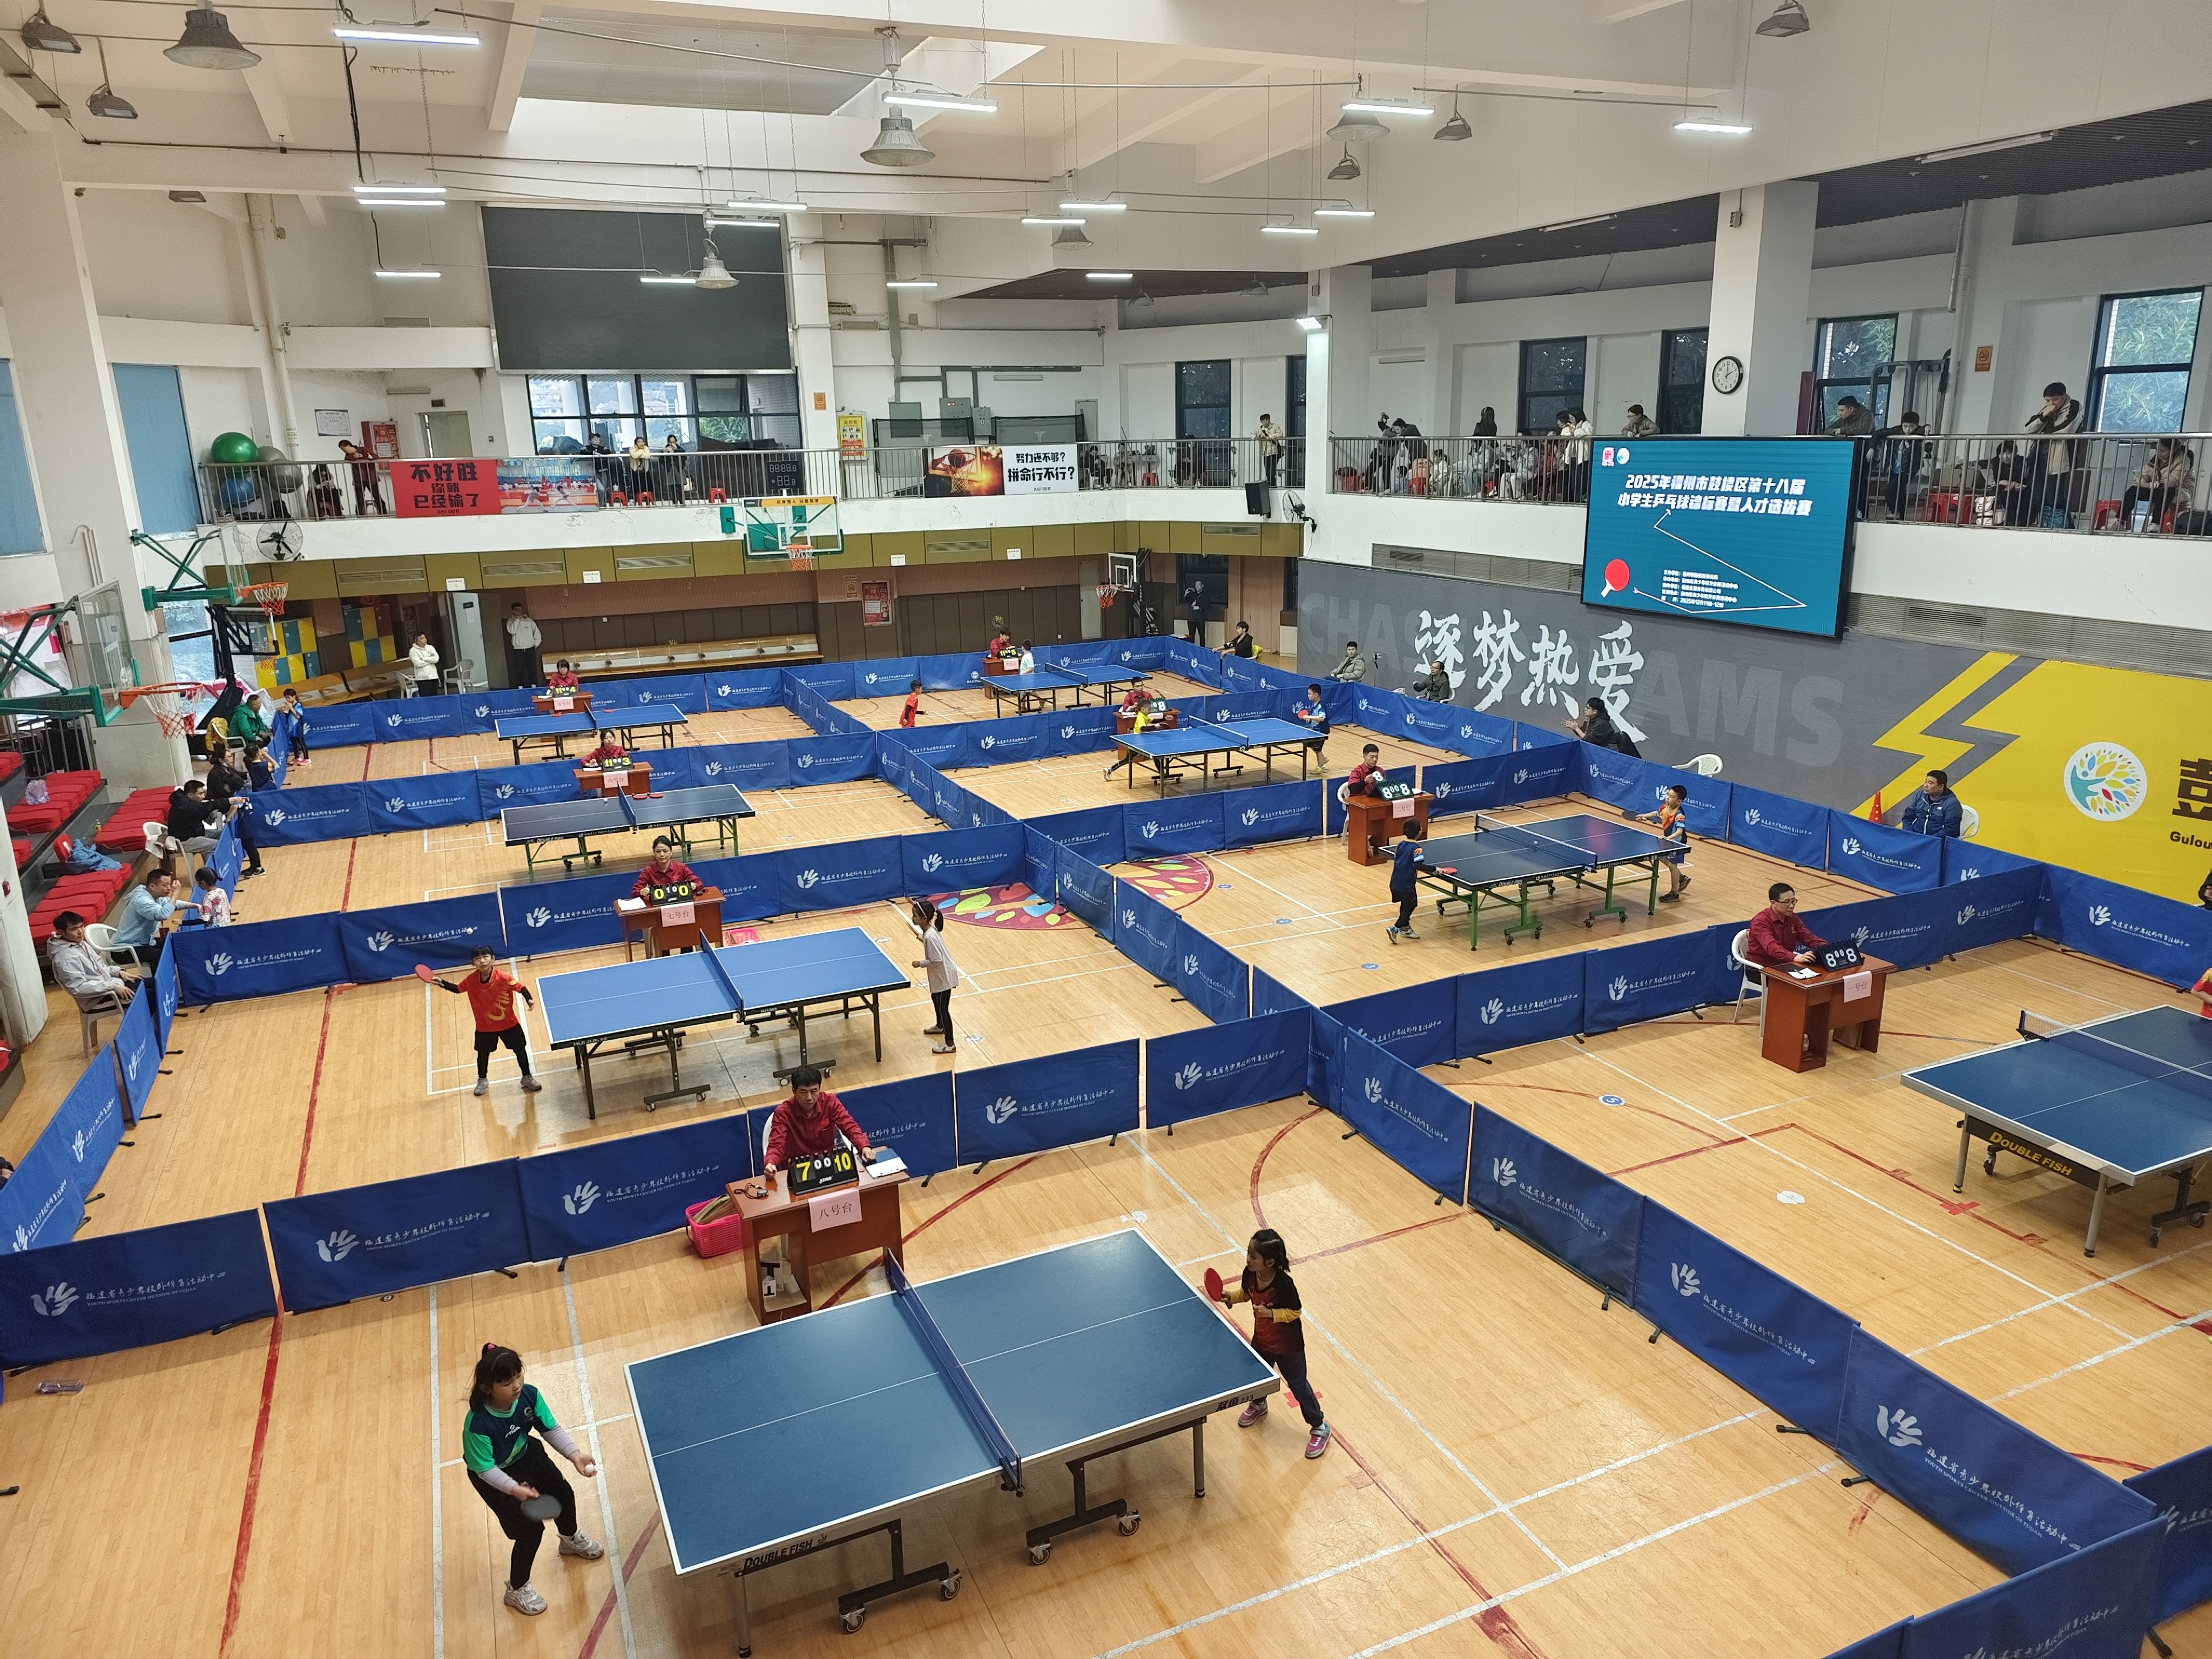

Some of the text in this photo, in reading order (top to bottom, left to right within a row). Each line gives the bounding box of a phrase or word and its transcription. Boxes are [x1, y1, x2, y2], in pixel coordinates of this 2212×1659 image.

[1016, 451, 1065, 463] 努力还不够？
[409, 462, 478, 482] 不好胜
[1007, 466, 1075, 482] 拼命行不行？
[413, 494, 479, 508] 已经输了
[1413, 608, 1650, 743] 逐梦热爱
[1157, 702, 1166, 711] 8
[604, 759, 613, 767] 11
[622, 757, 630, 765] 3
[1372, 771, 1382, 781] 8
[1382, 787, 1393, 798] 8
[1400, 784, 1410, 795] 8
[654, 888, 664, 899] 0
[679, 885, 689, 896] 0
[1826, 948, 1857, 967] 8 0 0 8
[1989, 1131, 2073, 1176] DOUBLE FISH
[796, 1152, 852, 1182] 7 0 0 10
[819, 1202, 852, 1220] 八号台
[365, 1211, 491, 1246] 福建省青少年校外体育活动中心
[85, 1271, 226, 1300] 福建省青少年校外体育活动中心
[1926, 1447, 2082, 1550] 福建省青少年校外体育活动中心
[744, 1539, 813, 1568] DOUBLE FISH
